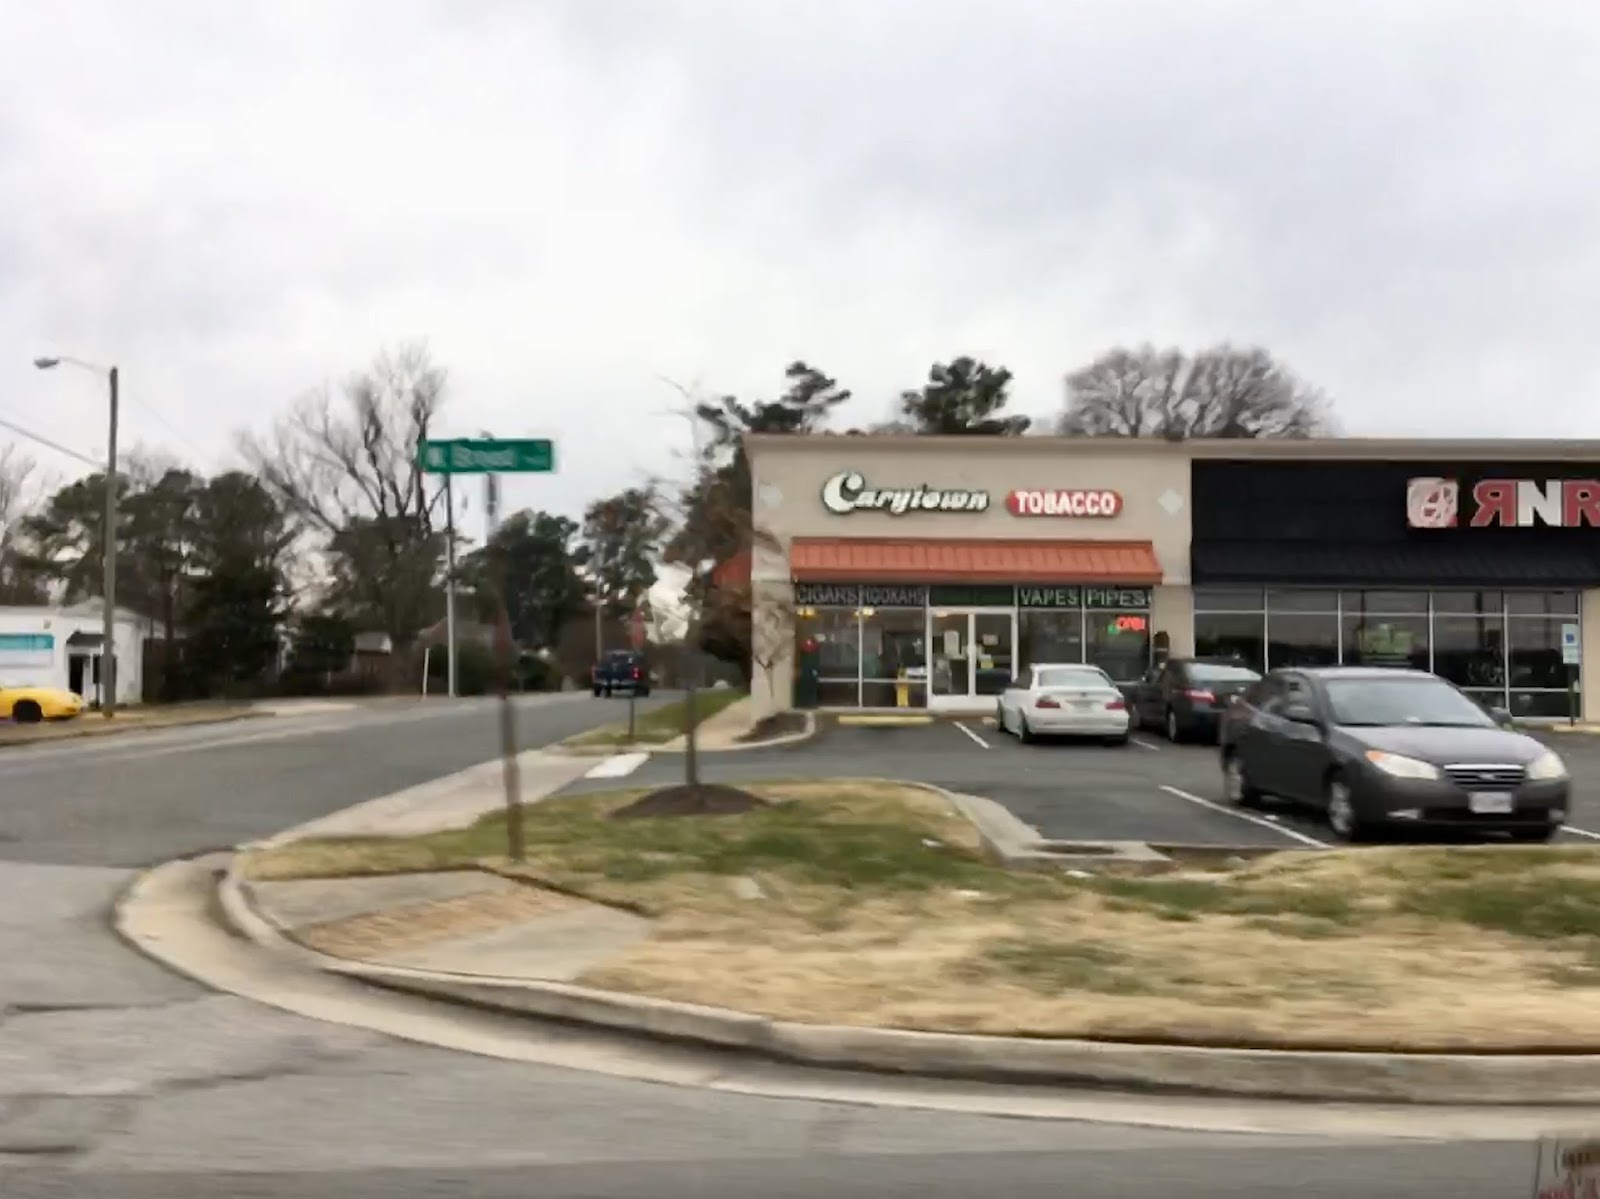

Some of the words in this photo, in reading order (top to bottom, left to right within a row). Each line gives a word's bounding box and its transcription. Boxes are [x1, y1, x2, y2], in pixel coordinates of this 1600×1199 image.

[822, 470, 989, 516] Carytown
[1014, 491, 1117, 514] TOBACCO
[797, 584, 858, 604] CIGARS
[1020, 588, 1079, 606] VAPES
[1087, 588, 1145, 606] PIPES
